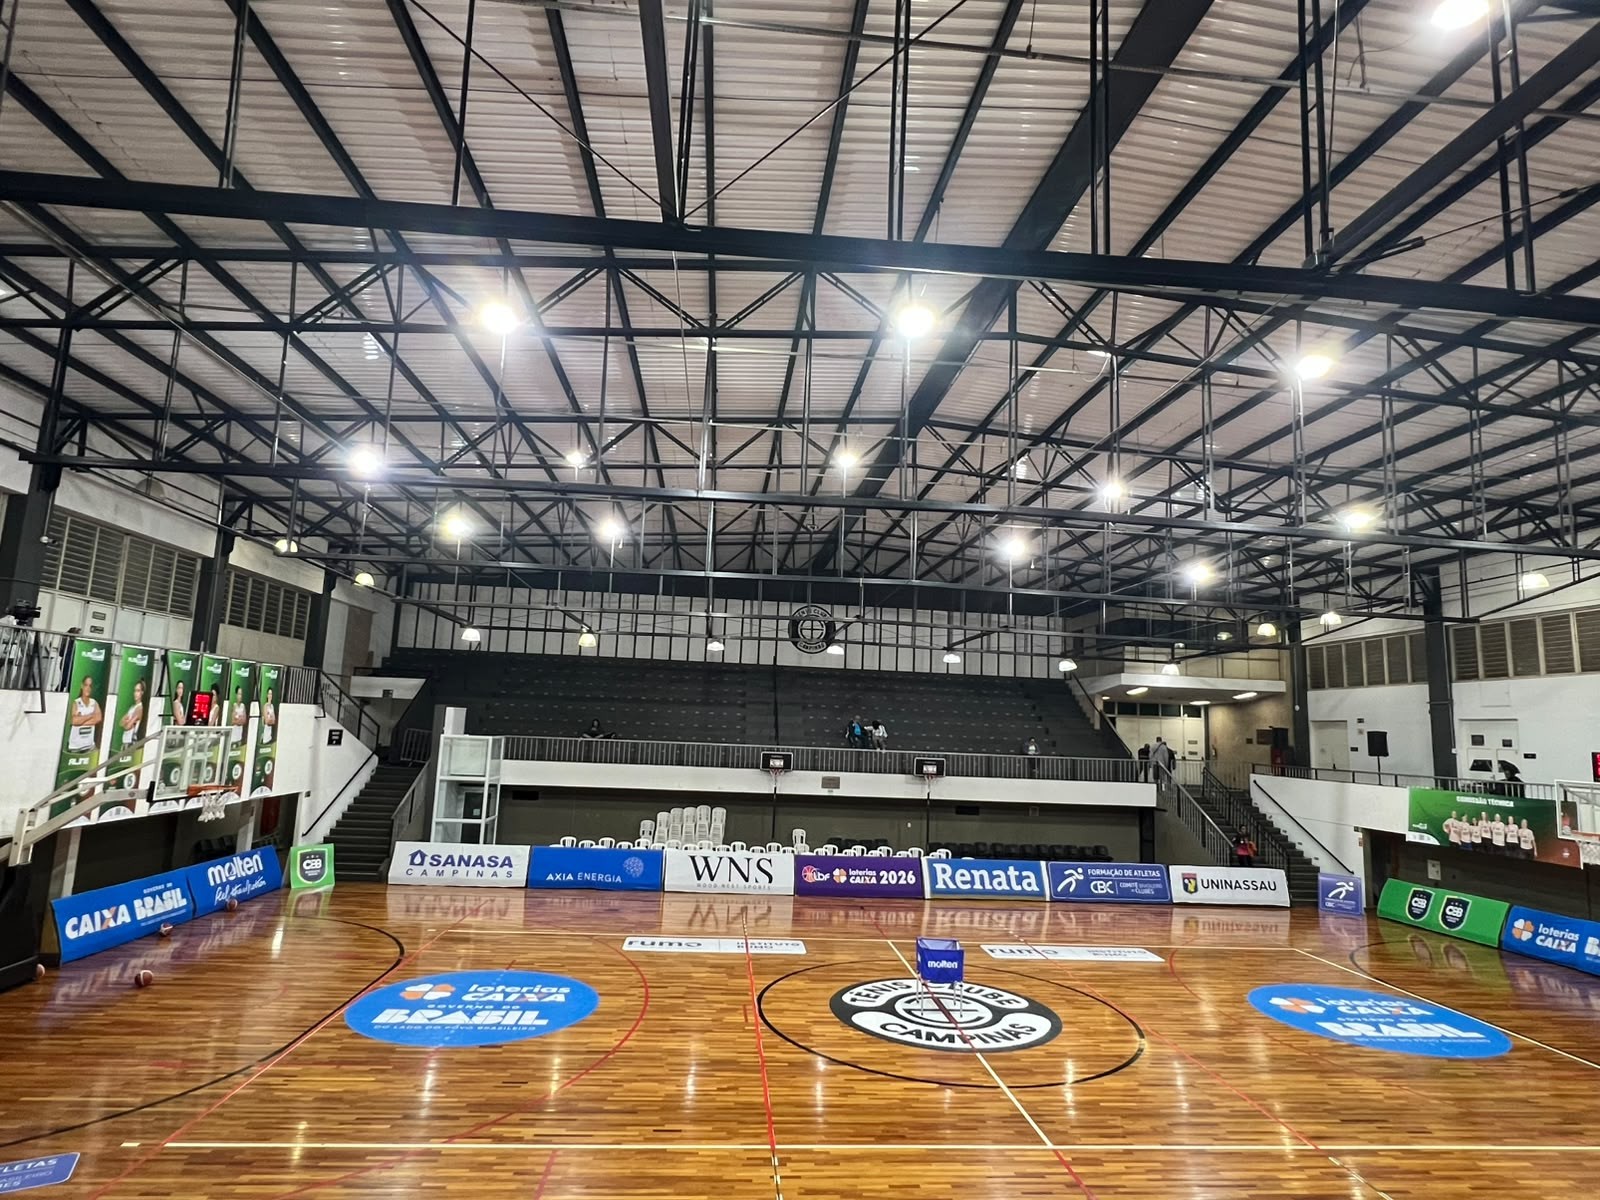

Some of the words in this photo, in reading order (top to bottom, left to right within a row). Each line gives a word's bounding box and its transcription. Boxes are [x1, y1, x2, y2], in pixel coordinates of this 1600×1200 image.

[429, 854, 513, 868] SANASA
[208, 854, 263, 886] molten
[406, 868, 512, 878] CAMPINAS
[688, 854, 773, 884] WNS
[849, 868, 876, 876] loterias
[1087, 867, 1123, 877] FORMAÇÃO
[546, 873, 574, 881] AXIA
[577, 872, 622, 883] ENERGIA
[849, 876, 877, 884] CAIXA
[879, 870, 916, 885] 2026
[932, 863, 1040, 892] Renata
[1090, 880, 1114, 894] CBC
[1201, 879, 1277, 891] UNINASSAU
[65, 904, 131, 939] CAIXA
[133, 888, 187, 920] BRASIL
[1538, 923, 1580, 941] loterias
[628, 940, 702, 948] rumo
[1535, 935, 1576, 953] CAIXA
[927, 960, 958, 969] molten
[468, 984, 571, 993] loterias
[461, 993, 567, 1003] CAIXA
[1315, 998, 1411, 1007] loterias
[371, 1008, 549, 1026] BRASIL
[1337, 1006, 1435, 1016] CAIXA
[879, 1022, 1037, 1045] CAMPINAS
[1315, 1021, 1486, 1038] BRASIL
